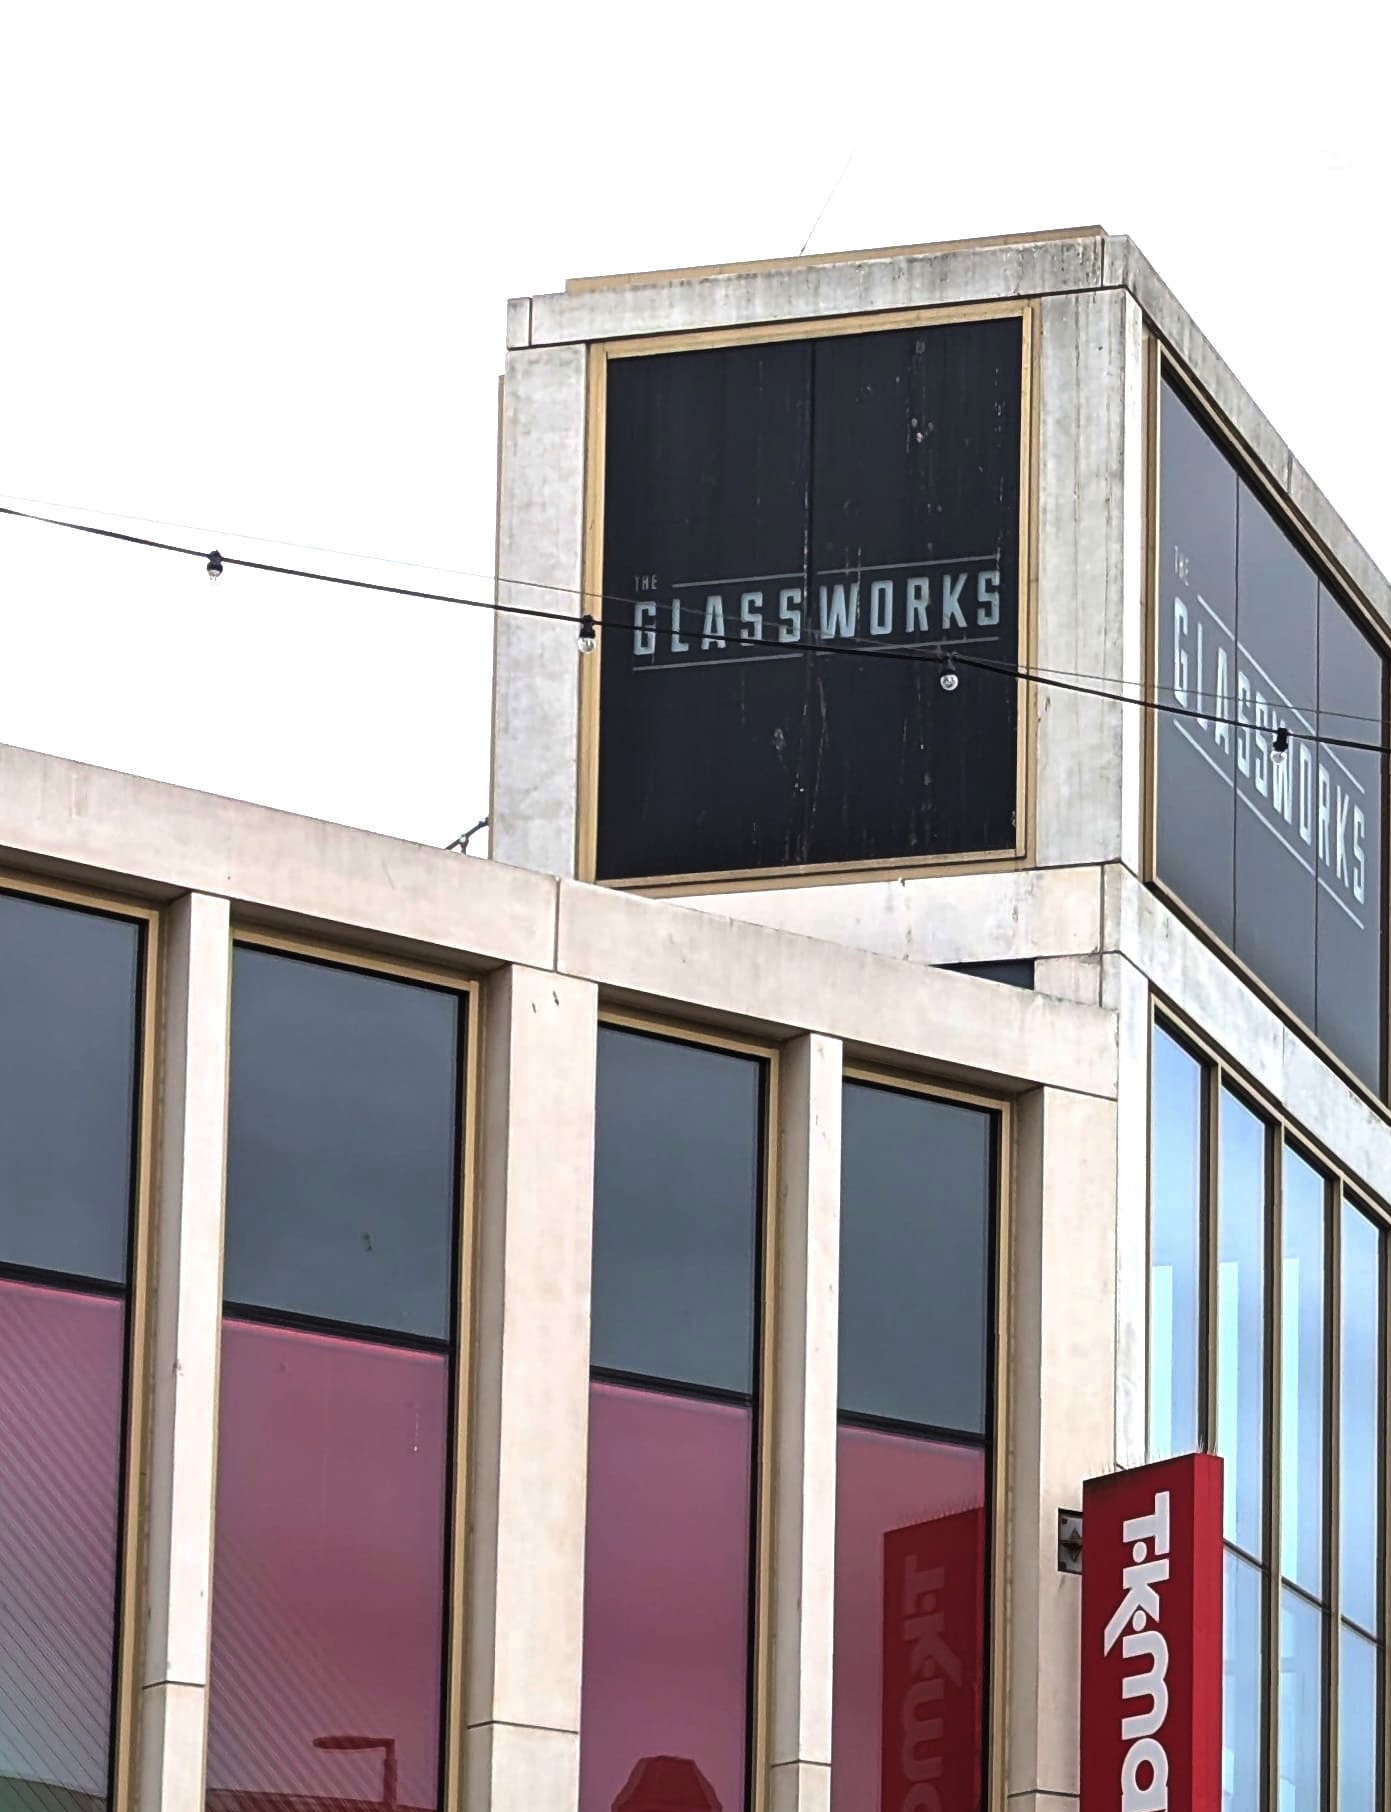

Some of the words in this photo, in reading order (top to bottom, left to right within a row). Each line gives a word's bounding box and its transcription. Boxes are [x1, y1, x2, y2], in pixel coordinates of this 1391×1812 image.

[632, 570, 1001, 656] GLASSWORKS
[634, 574, 658, 592] THE
[1173, 596, 1366, 905] GLASSWORKS
